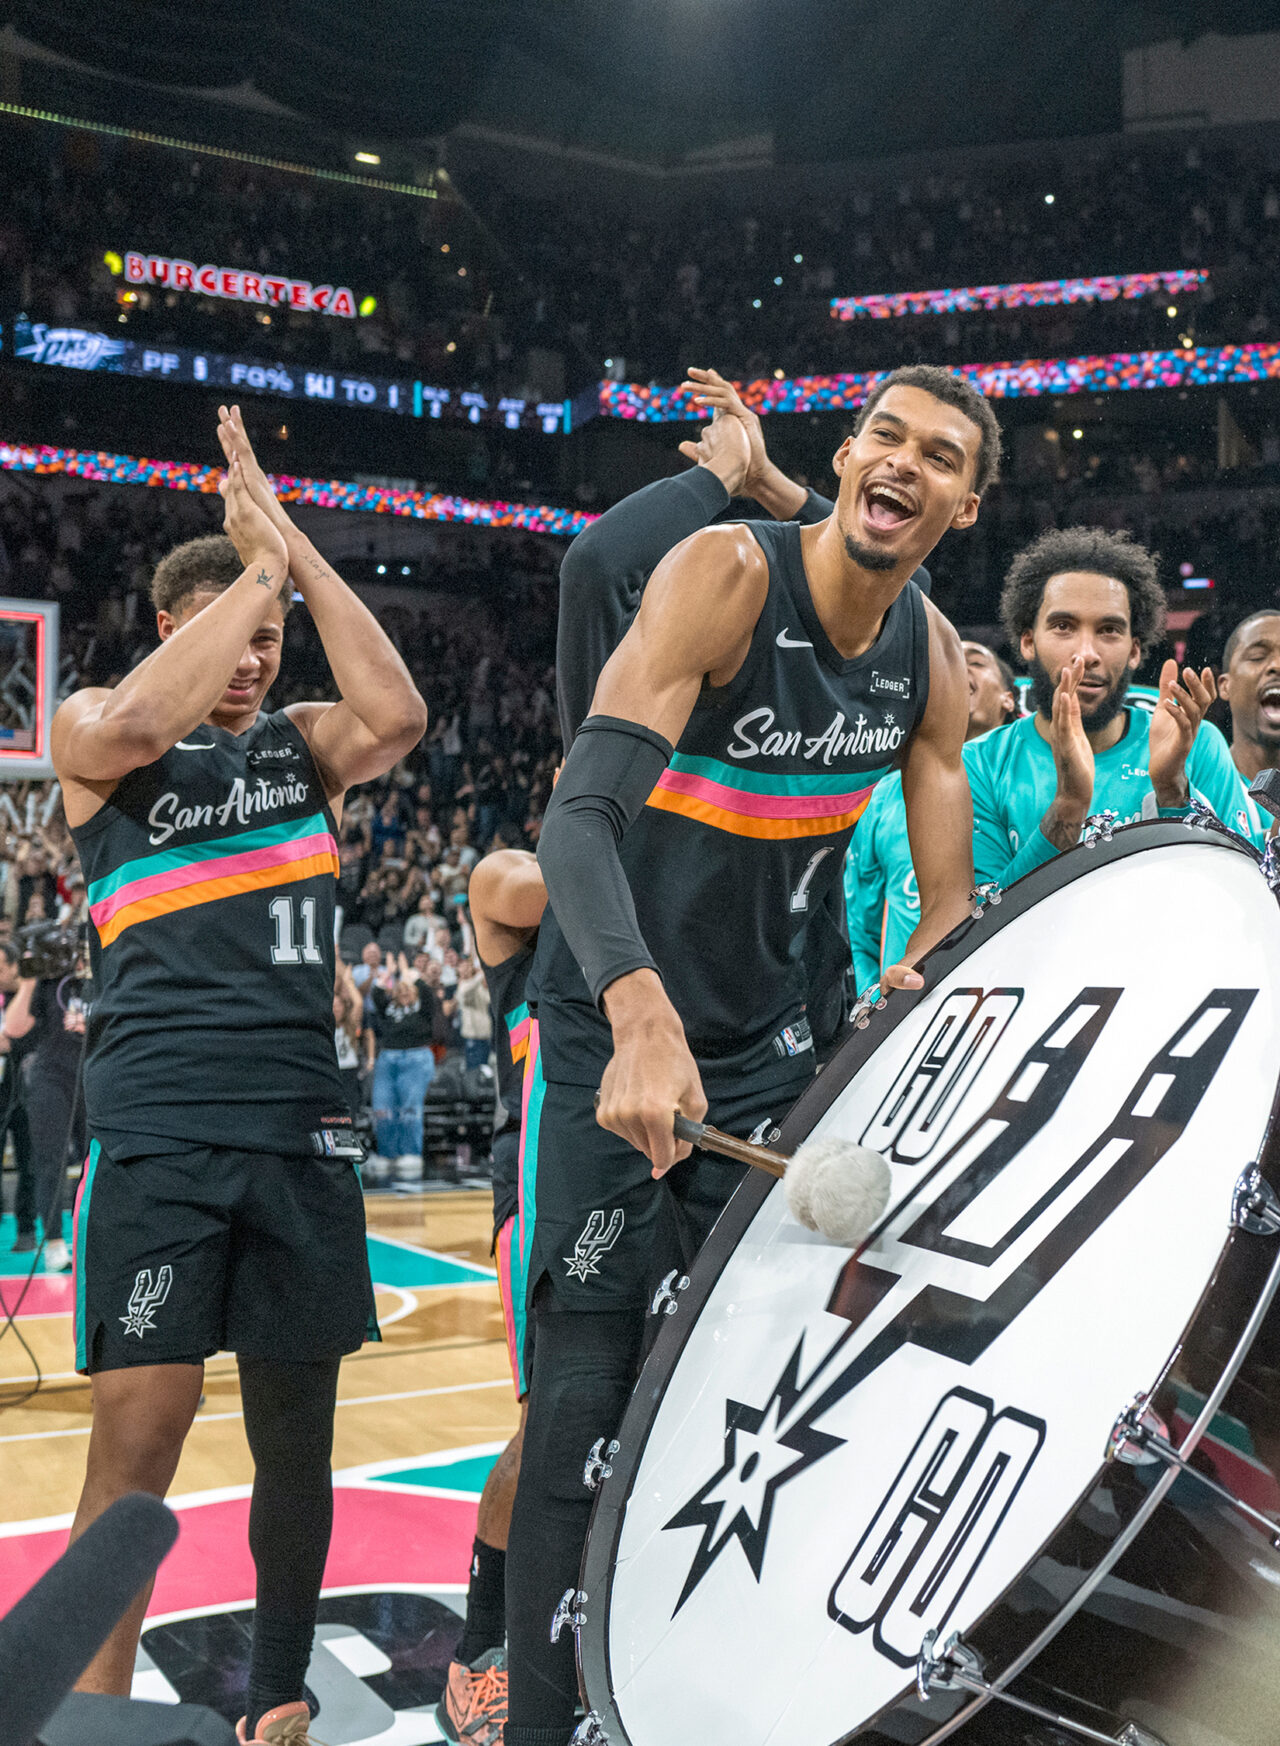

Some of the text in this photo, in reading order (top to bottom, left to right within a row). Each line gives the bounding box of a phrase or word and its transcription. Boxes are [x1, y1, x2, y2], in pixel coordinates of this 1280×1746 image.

[124, 251, 357, 318] BURGERTECA
[142, 349, 180, 375] PF
[341, 378, 377, 404] TO
[874, 677, 906, 693] LEDGER
[254, 747, 293, 761] LEDGER
[726, 706, 906, 766] San Antonio
[147, 771, 310, 846] San Antonio
[789, 846, 835, 913] 1
[269, 896, 324, 965] 11
